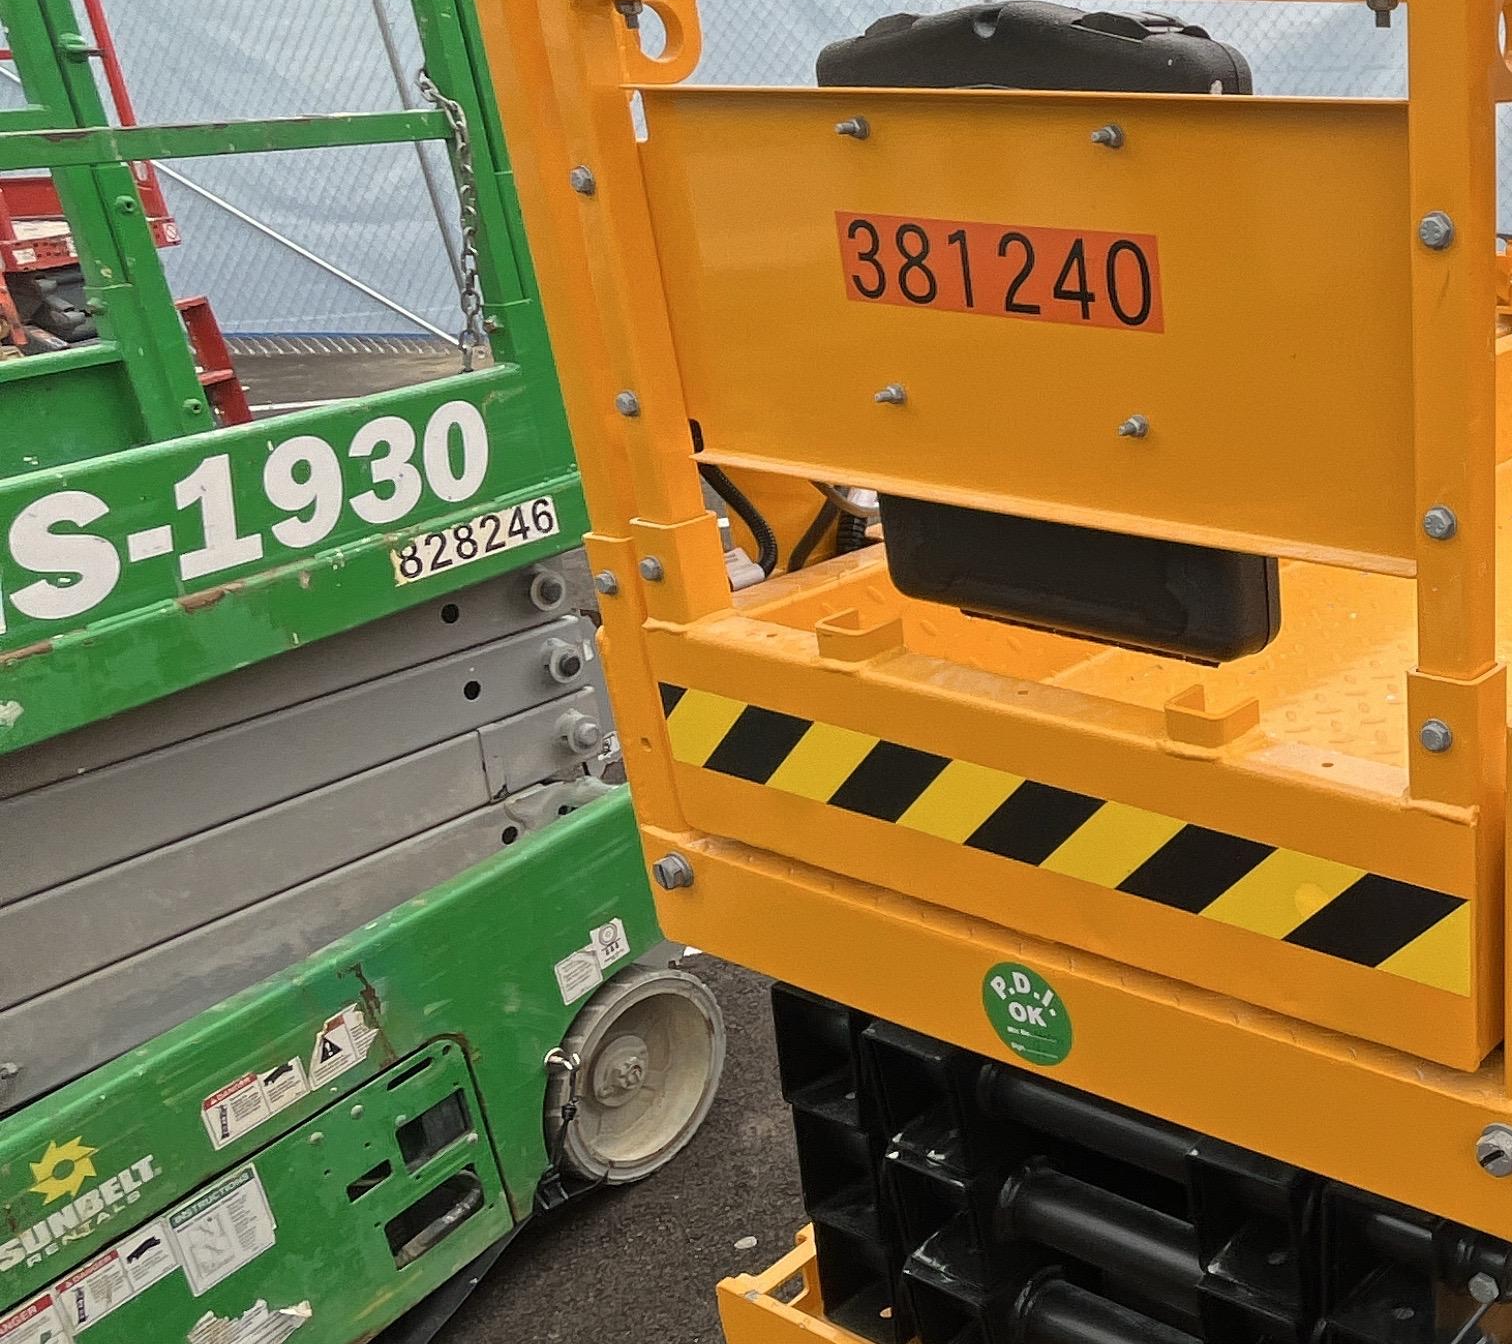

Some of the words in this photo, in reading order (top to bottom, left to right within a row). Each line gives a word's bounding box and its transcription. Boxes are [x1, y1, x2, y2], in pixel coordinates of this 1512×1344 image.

[847, 219, 1153, 327] 381240
[0, 400, 489, 635] S-1930
[398, 498, 555, 579] 828246
[1008, 1001, 1048, 1028] OK
